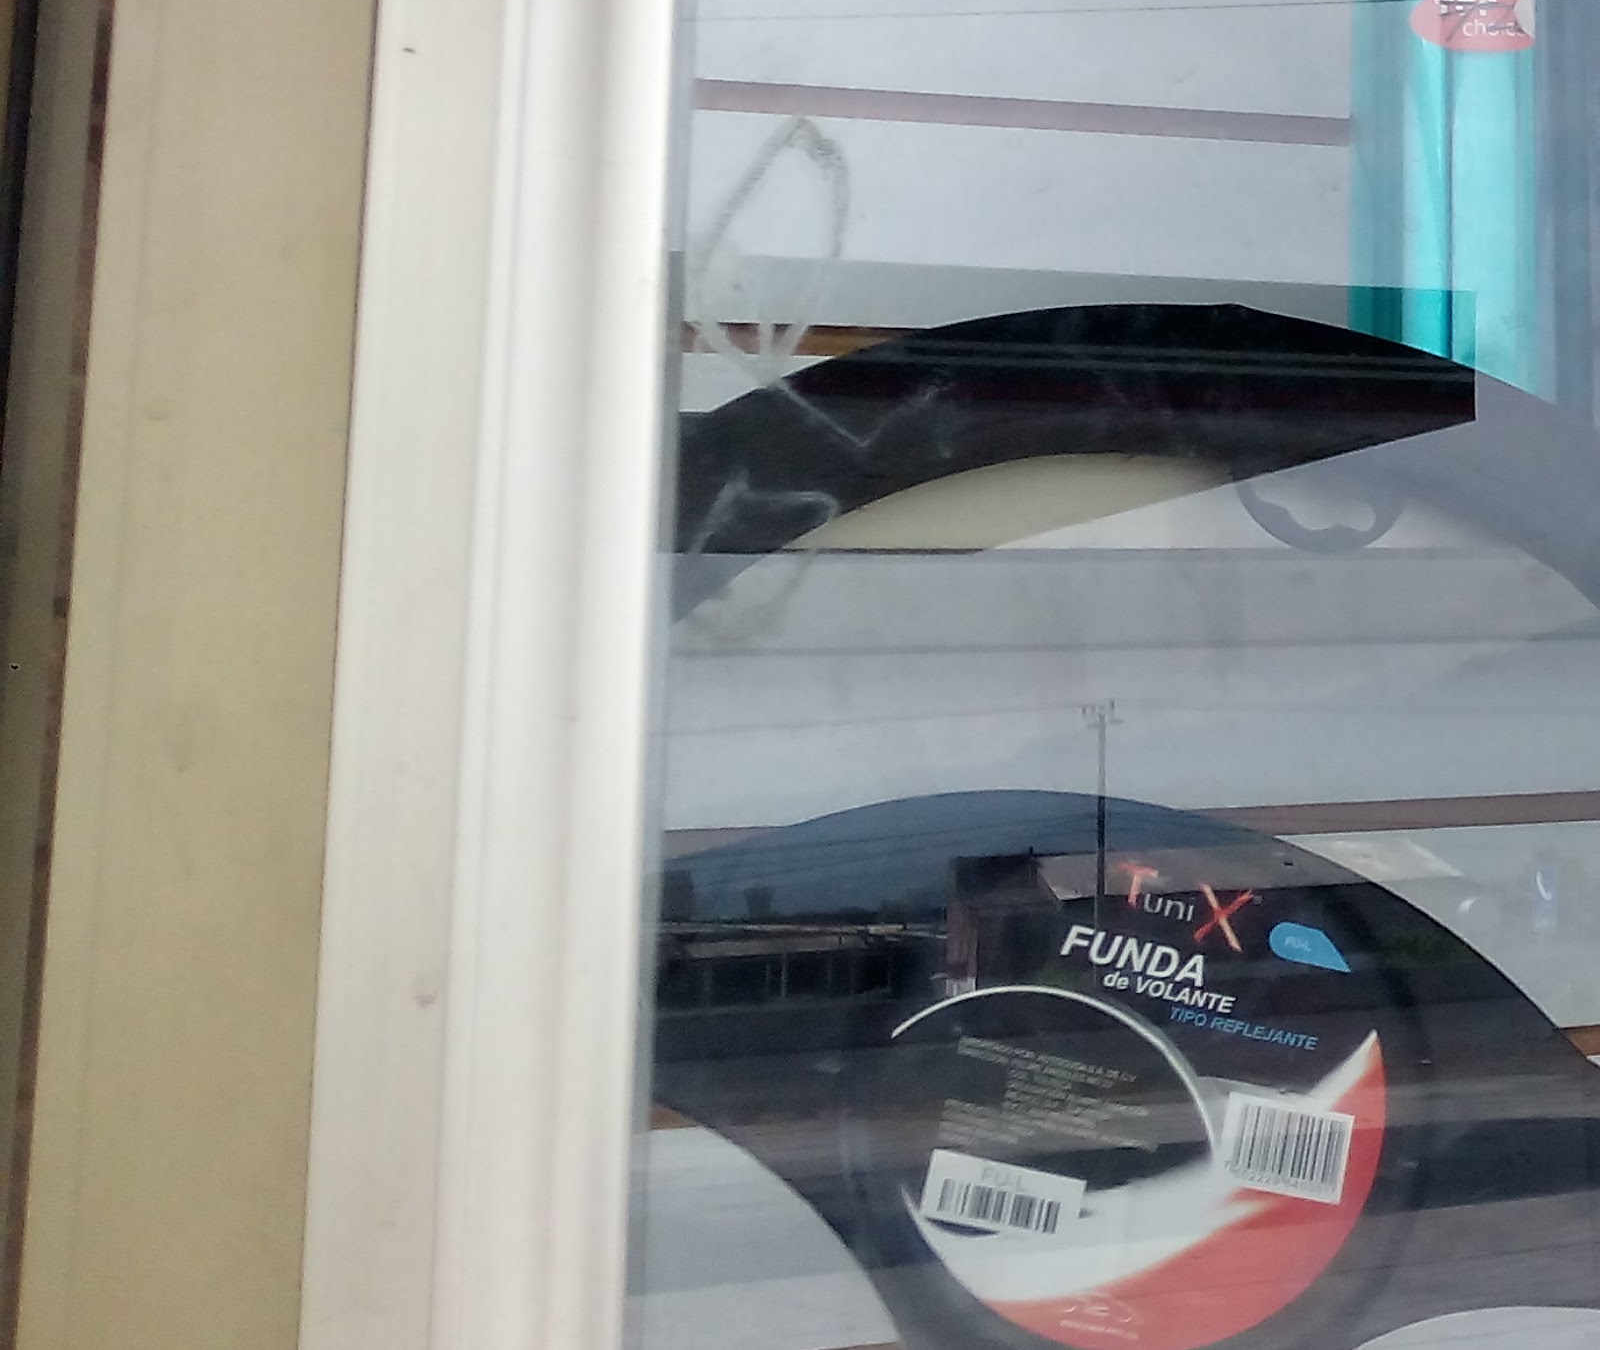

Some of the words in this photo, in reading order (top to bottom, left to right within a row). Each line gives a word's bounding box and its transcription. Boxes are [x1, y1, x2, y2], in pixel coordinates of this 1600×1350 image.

[1060, 925, 1206, 987] FUNDA
[1103, 971, 1130, 990] de
[1136, 974, 1236, 1014] VOLANTE
[1169, 1006, 1208, 1027] TIPO
[1212, 1016, 1320, 1051] REFLEJANTE
